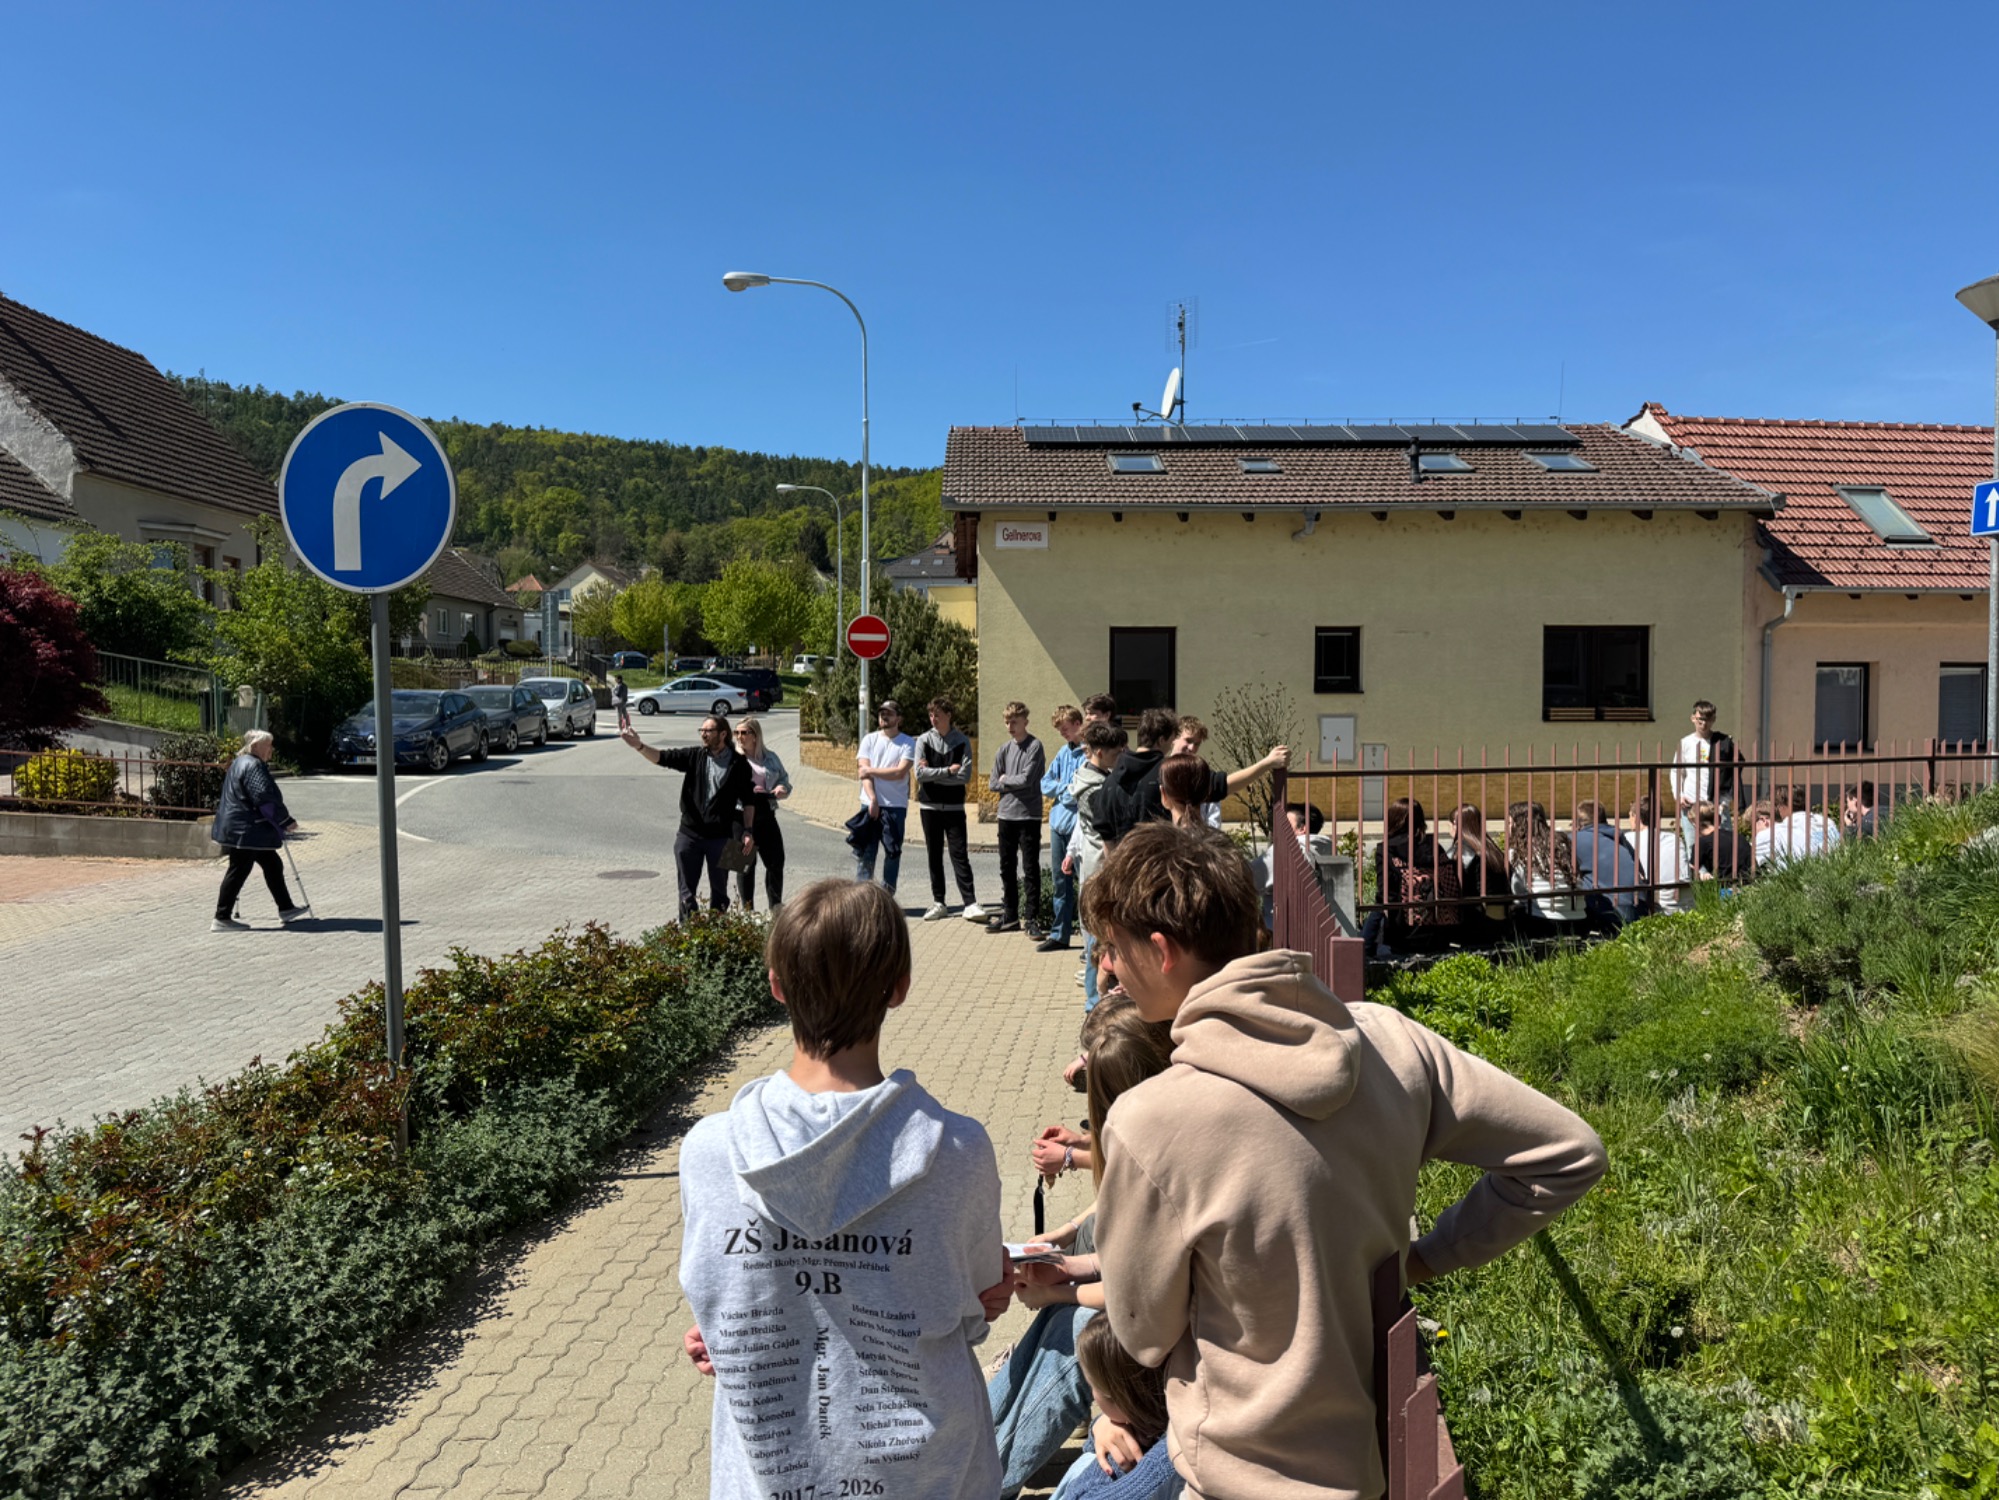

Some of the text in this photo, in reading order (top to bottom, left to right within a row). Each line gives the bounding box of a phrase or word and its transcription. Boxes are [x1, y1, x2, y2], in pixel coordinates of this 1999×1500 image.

[724, 1218, 913, 1255] ZŠ Jasanová
[795, 1271, 843, 1296] 9.B
[813, 1326, 830, 1361] Mgr.
[817, 1364, 830, 1390] Jan
[839, 1478, 885, 1498] 2026
